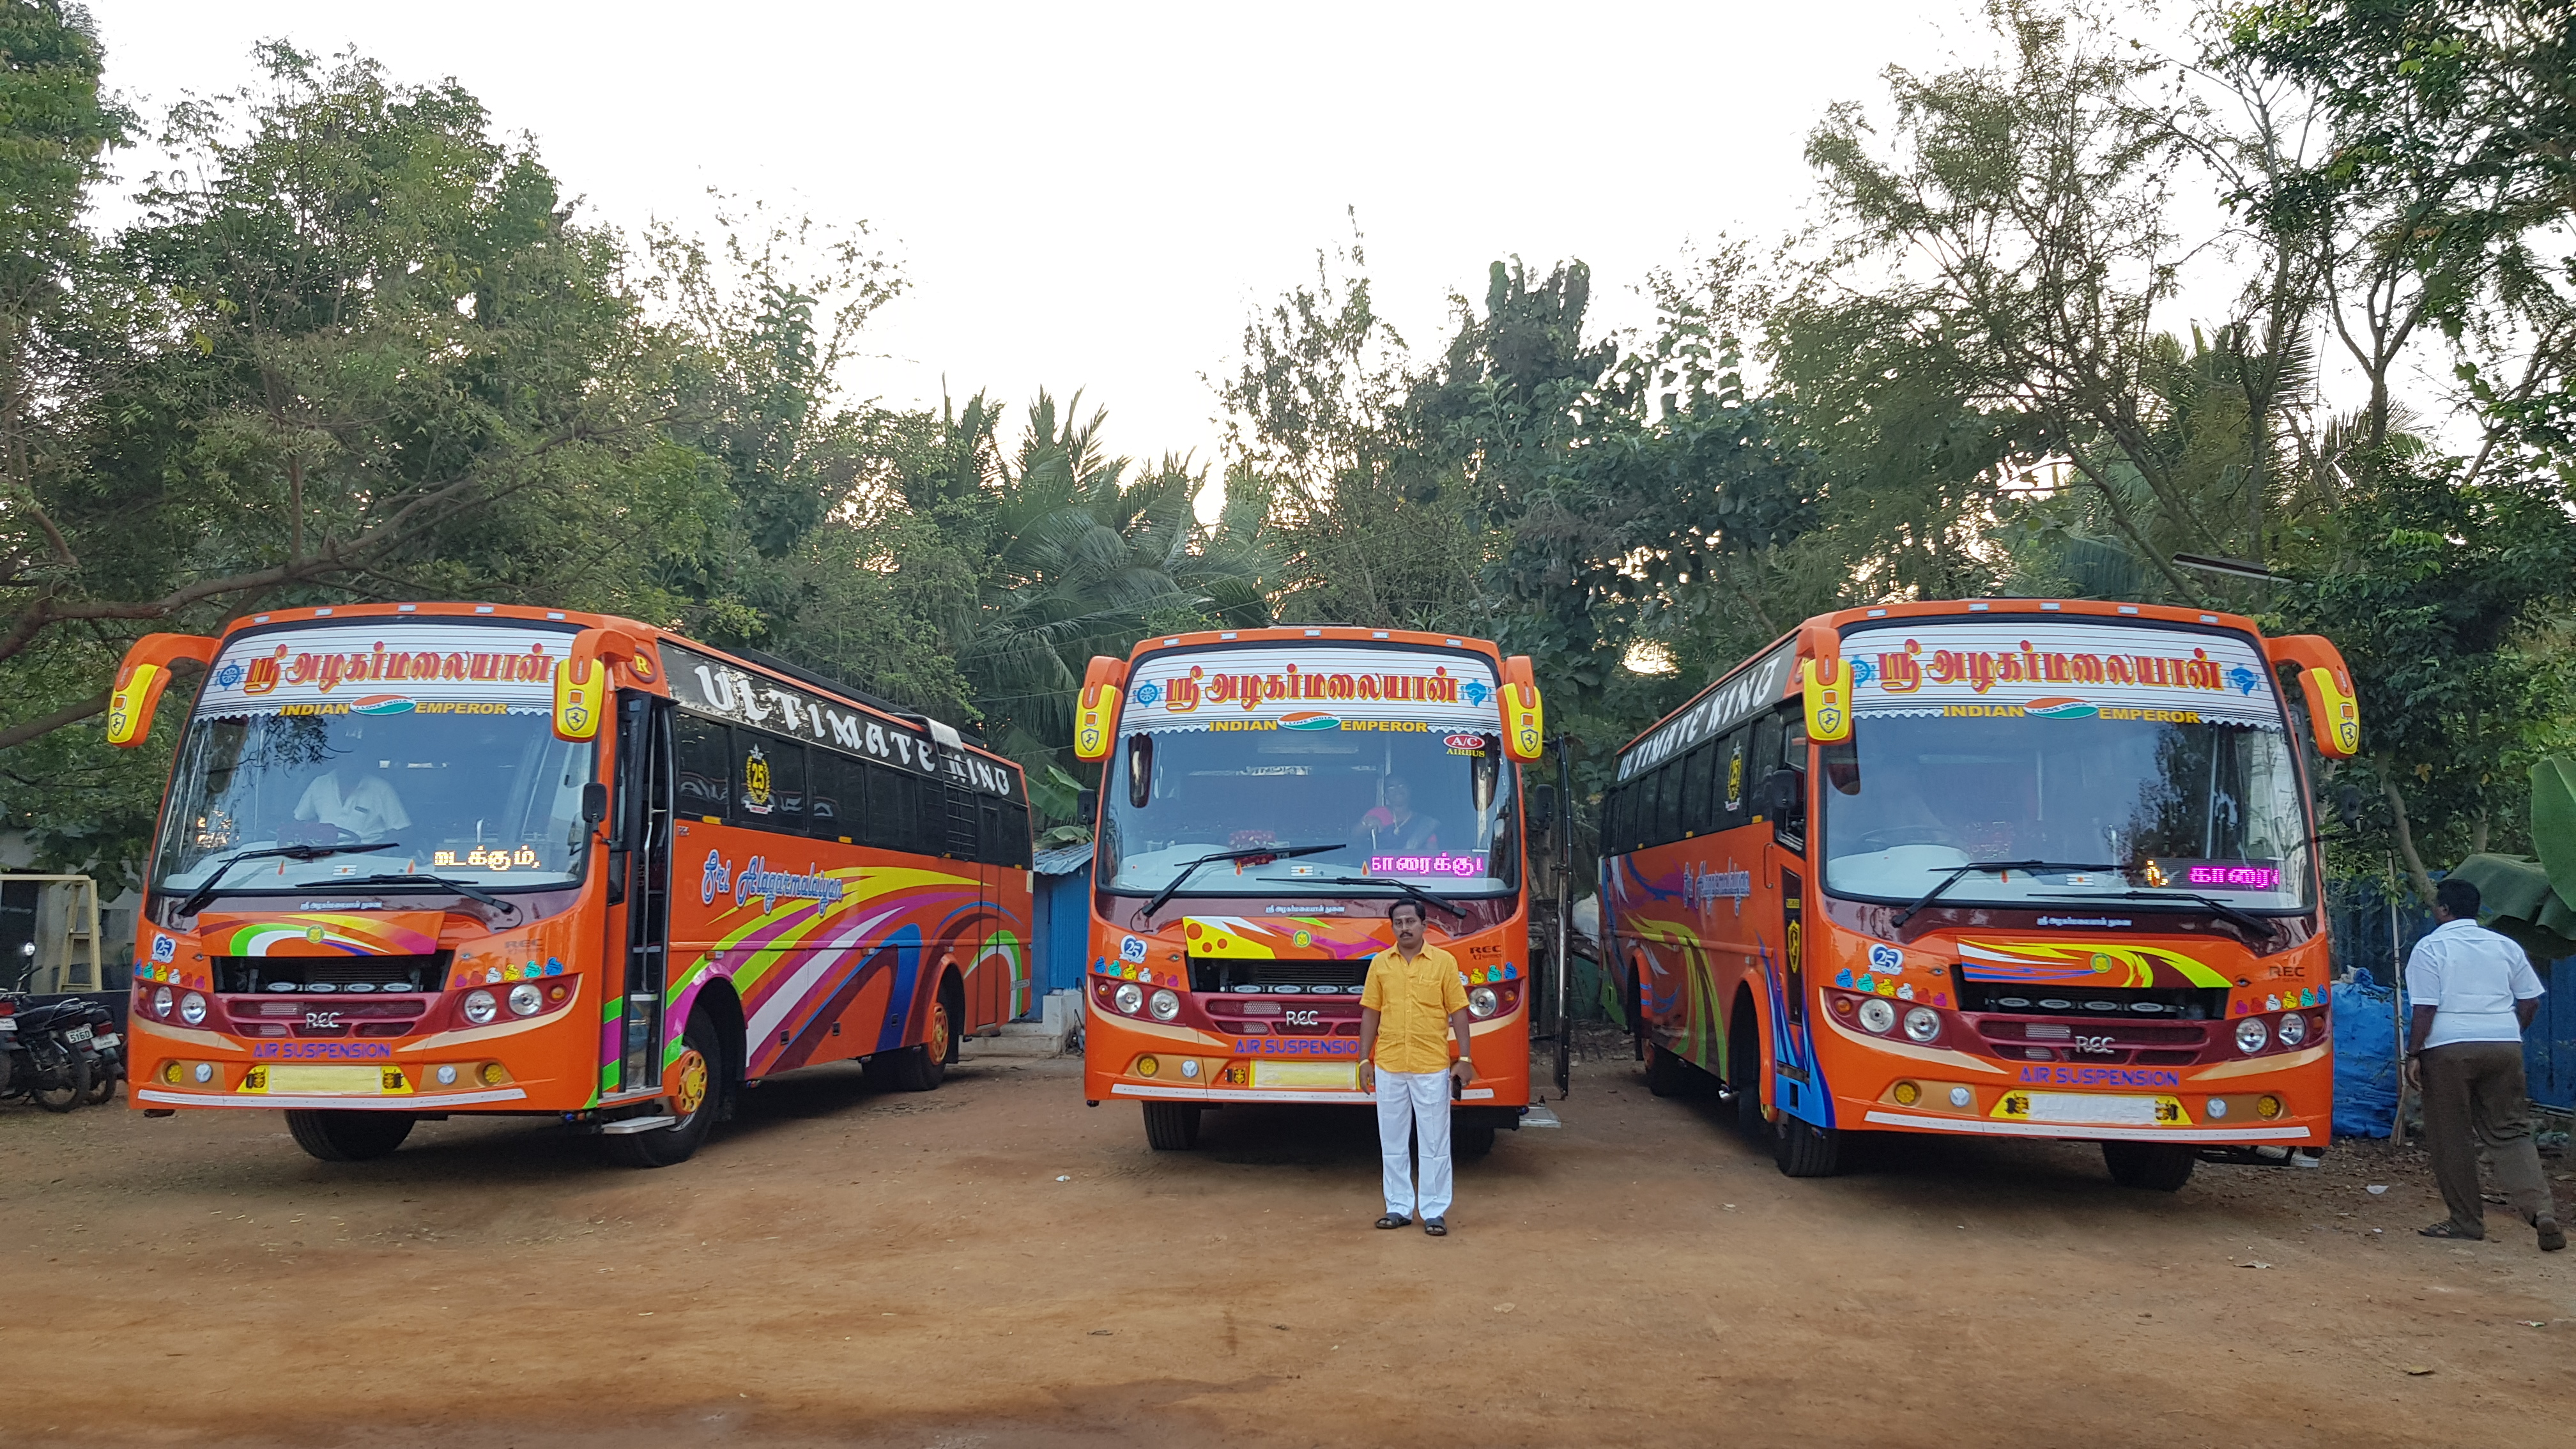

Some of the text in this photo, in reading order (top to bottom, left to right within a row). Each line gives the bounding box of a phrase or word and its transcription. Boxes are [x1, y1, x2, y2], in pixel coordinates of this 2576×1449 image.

[286, 641, 554, 693] அழகர்மலையான்
[634, 655, 650, 675] R
[1926, 640, 2225, 694] அழகர்மலையான்
[1205, 663, 1459, 710] அழகர்மலையான்
[279, 703, 507, 716] INDIAN EMPEROR
[694, 665, 935, 772] ULTIMATE
[1617, 656, 1781, 781] ULTIMATE KING
[1943, 705, 2202, 723] INDIAN EMPEROR
[1209, 720, 1428, 733] INDIAN EMPEROR
[1452, 737, 1477, 746] A/C
[1446, 748, 1485, 758] AIRBUS
[752, 763, 765, 789] 25
[702, 849, 732, 905] Sri
[156, 940, 170, 957] 25
[1125, 940, 1140, 958] 25
[1875, 950, 1895, 969] 25
[2269, 966, 2305, 977] REC
[305, 1012, 344, 1029] REC
[1285, 1010, 1318, 1026] REC
[70, 1031, 90, 1042] 5160
[2074, 1036, 2115, 1054] REC
[252, 1042, 391, 1059] AIR SUSPENSION
[1234, 1039, 1359, 1054] AIR SUSPENSIO
[2019, 1066, 2180, 1086] AIR SUSPENSION
